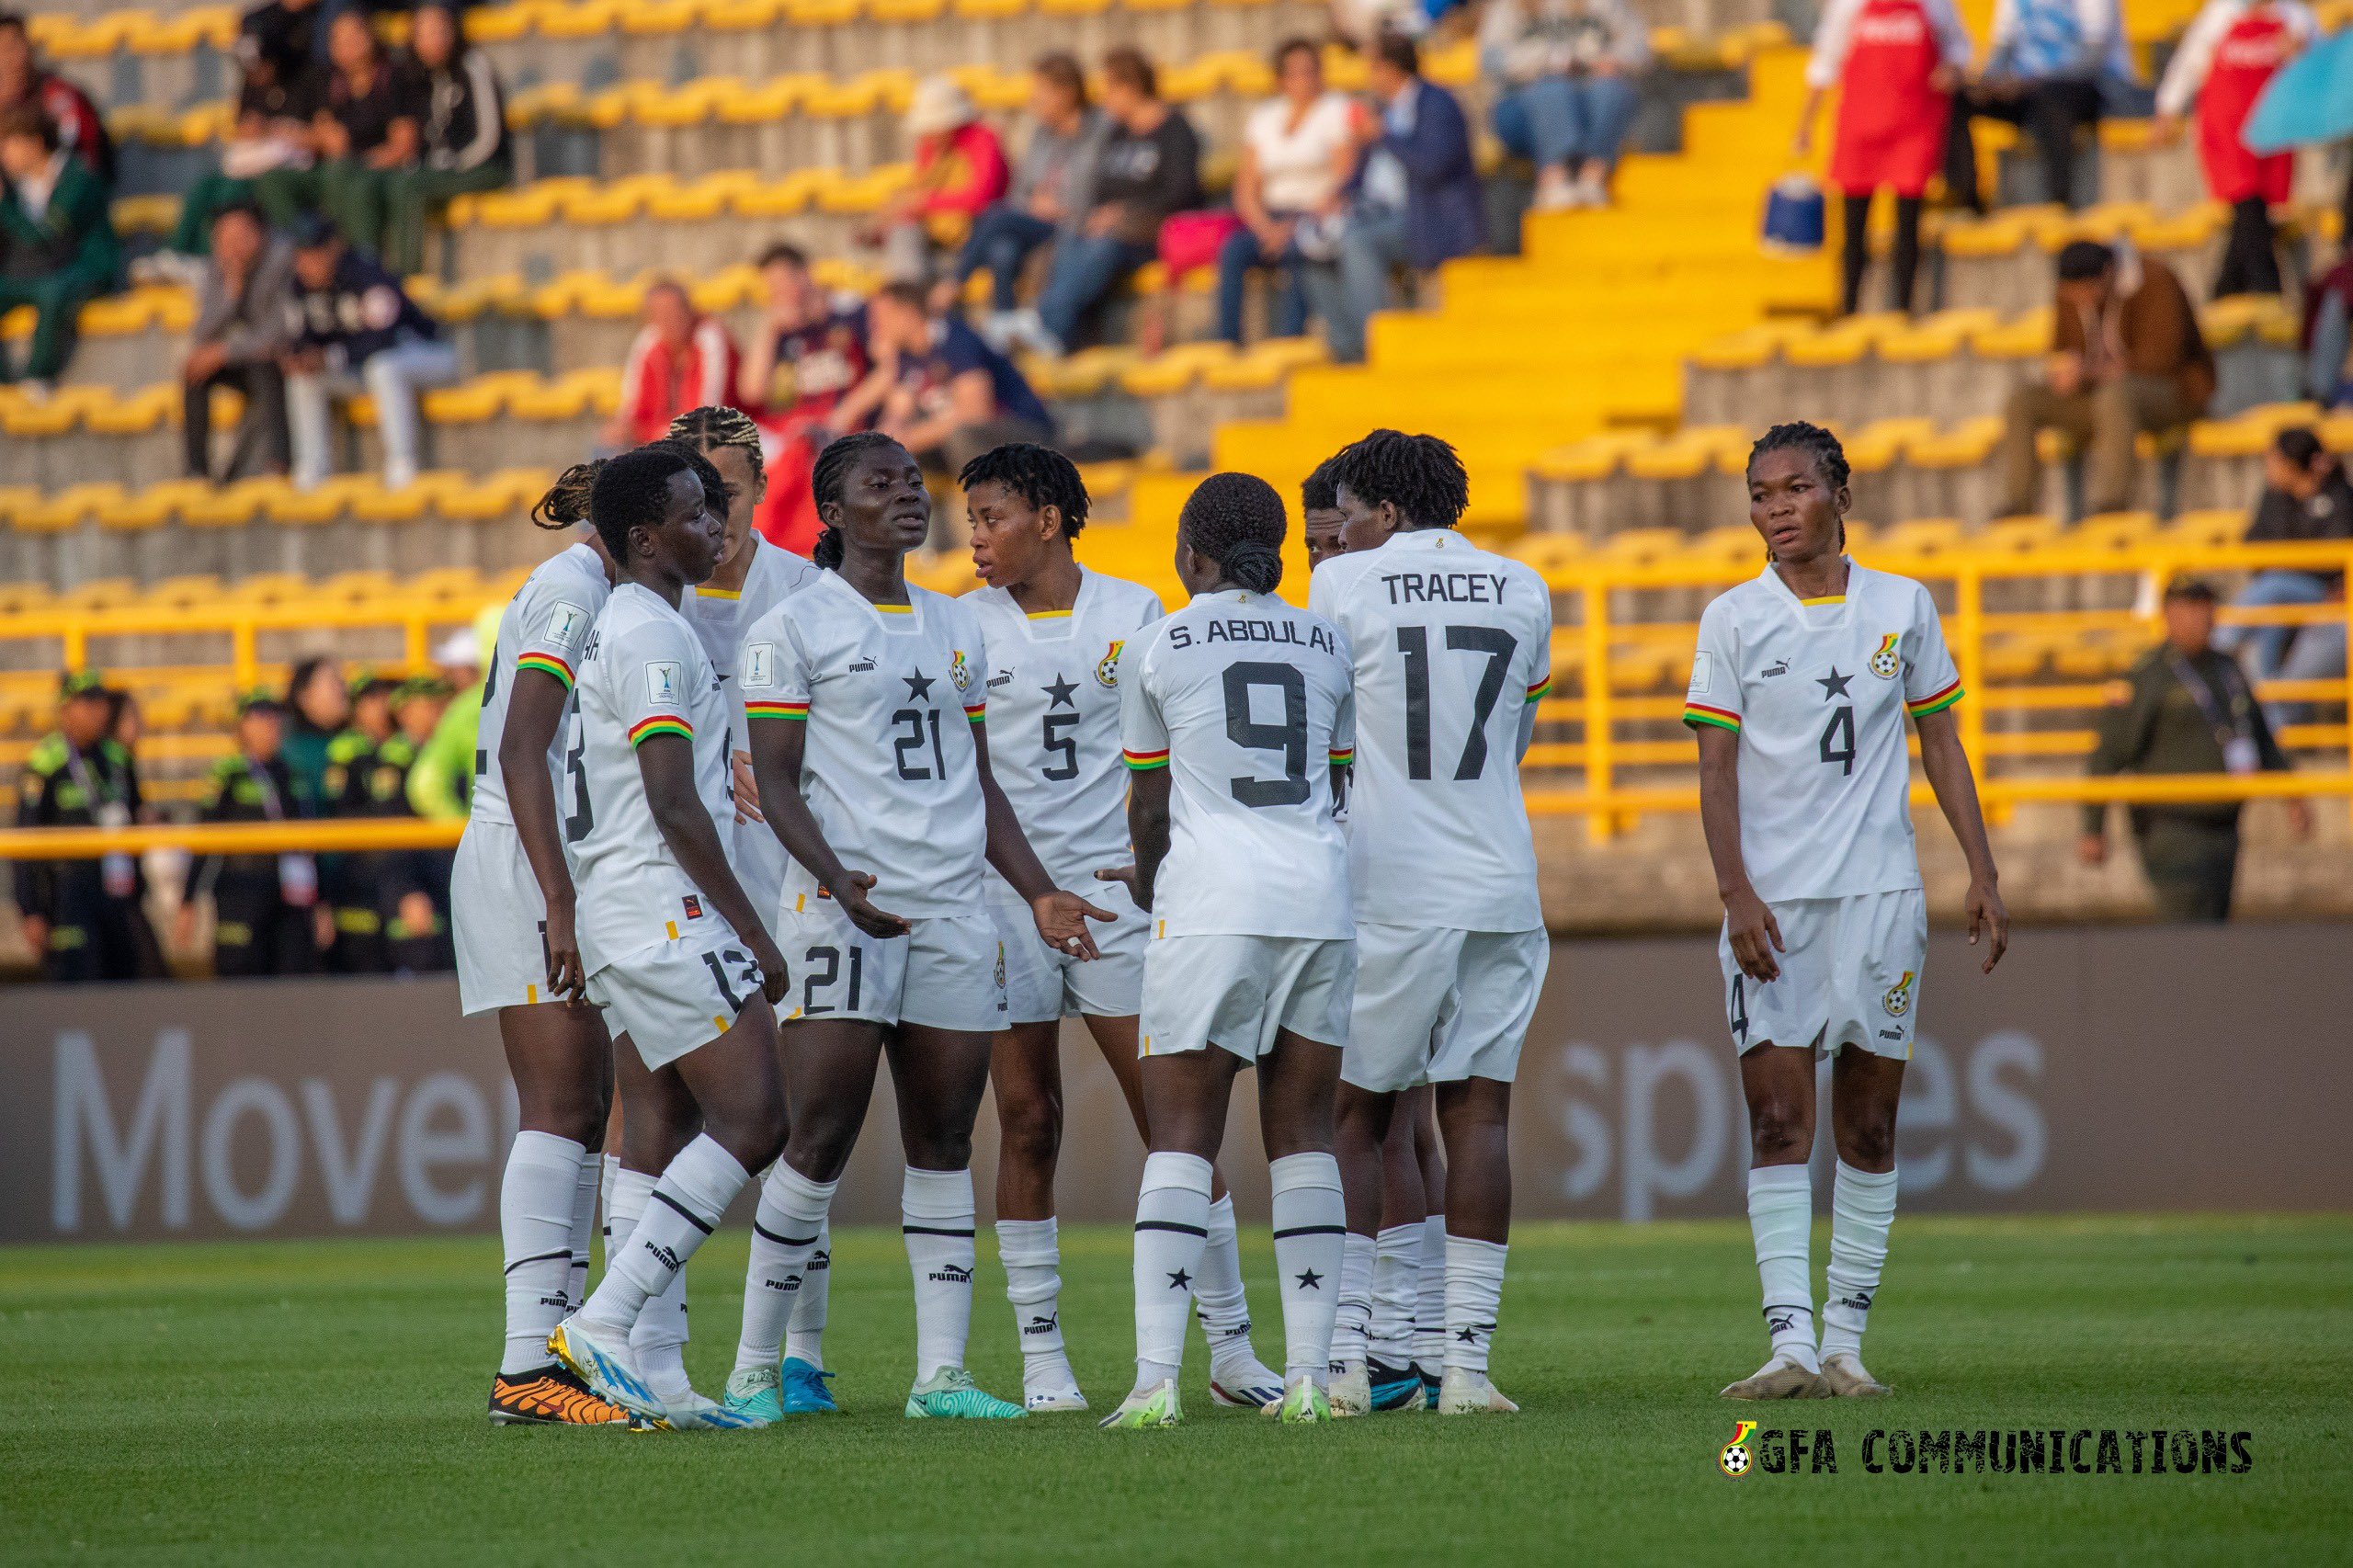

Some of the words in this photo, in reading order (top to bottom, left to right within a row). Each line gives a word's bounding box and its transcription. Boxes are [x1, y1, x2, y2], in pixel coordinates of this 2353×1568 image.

[1381, 574, 1507, 605] TRACEY
[1169, 625, 1201, 650] S.
[1207, 619, 1335, 655] ABDULAI
[848, 662, 875, 674] PUMA
[985, 675, 1011, 688] PUMA
[1761, 666, 1786, 679] PUMA
[1396, 625, 1518, 781] 17
[891, 709, 947, 781] 21
[1041, 712, 1081, 782] 5
[1222, 661, 1311, 808] 9
[1819, 705, 1857, 777] 4
[803, 946, 863, 1017] 21
[1731, 972, 1749, 1046] 4
[1879, 1029, 1903, 1041] PUMA
[52, 1027, 521, 1233] Move
[644, 1241, 678, 1273] PUMA
[806, 1260, 828, 1271] UMA
[765, 1278, 800, 1291] PUMA
[928, 1272, 968, 1283] PUMA
[1024, 1324, 1054, 1335] PUMA
